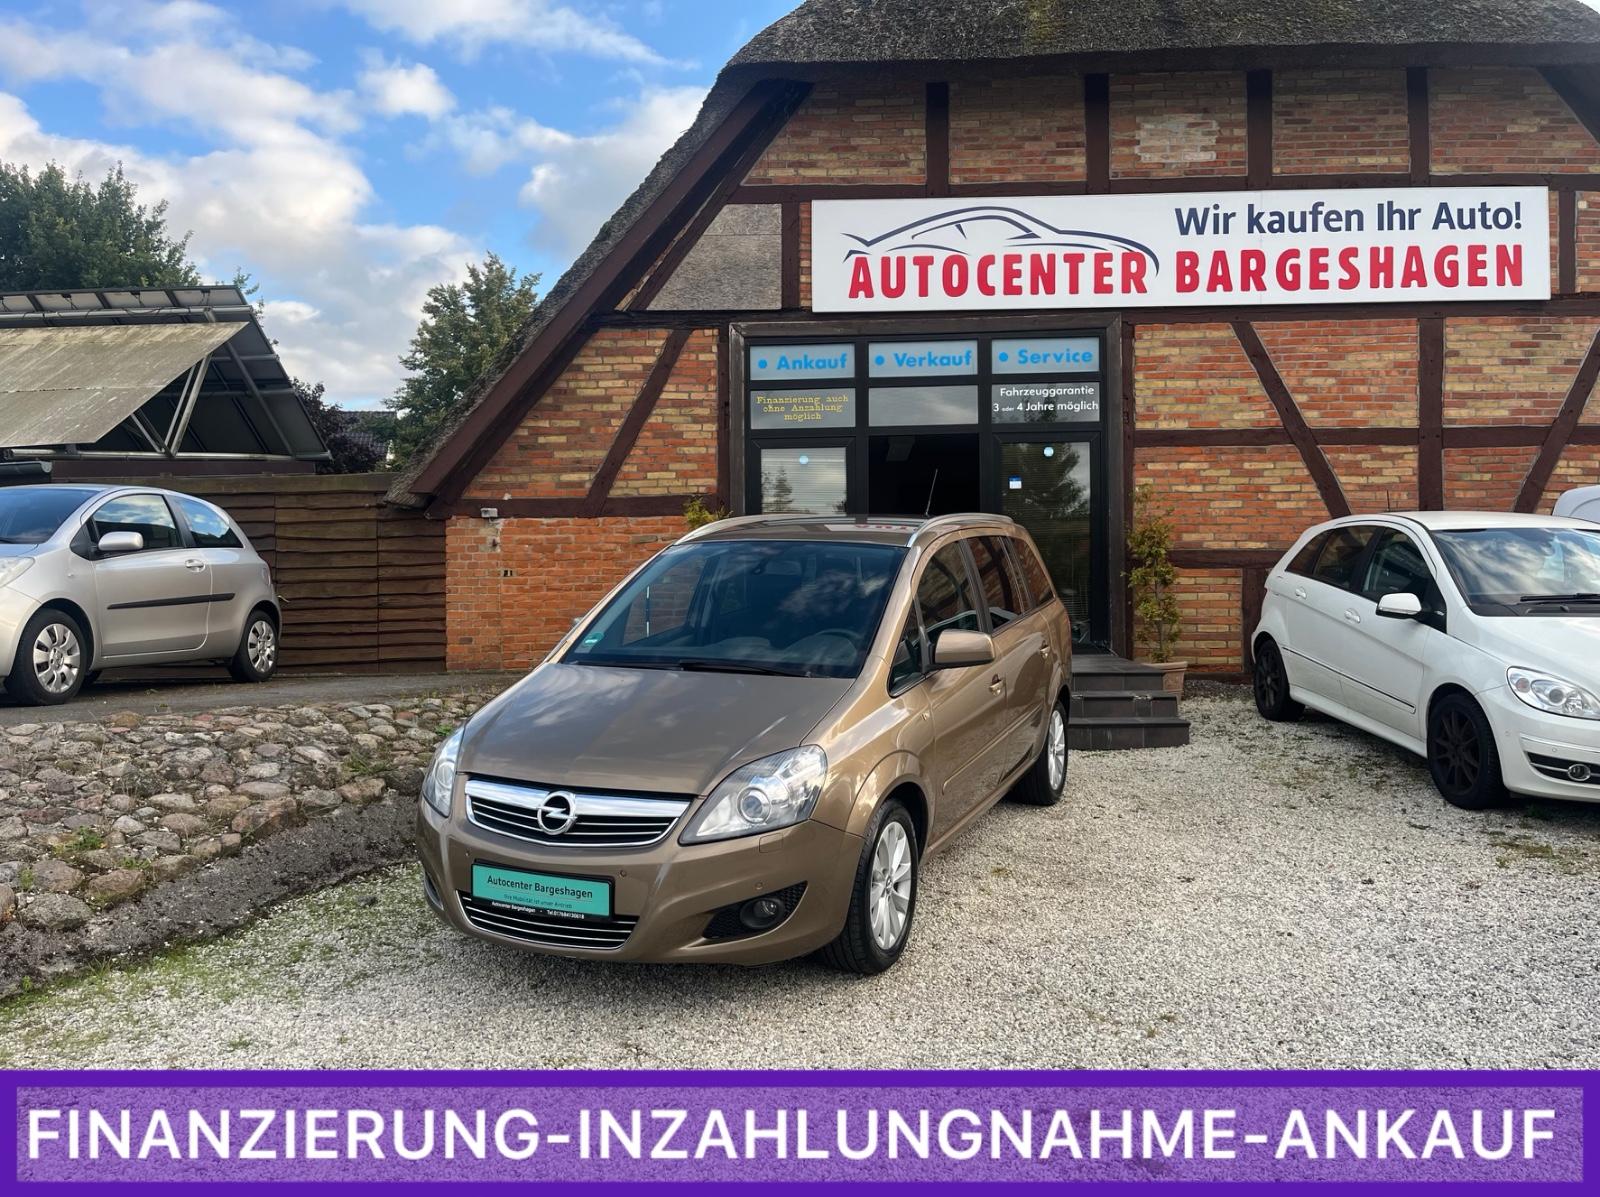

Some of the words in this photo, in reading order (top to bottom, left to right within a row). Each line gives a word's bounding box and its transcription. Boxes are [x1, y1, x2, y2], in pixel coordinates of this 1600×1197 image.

[1174, 203, 1237, 236] Wir
[1247, 201, 1364, 234] kaufen
[1376, 200, 1422, 231] Ihr
[1432, 201, 1522, 231] Auto!
[848, 252, 1147, 299] AUTOCENTER
[1175, 244, 1522, 293] BARGESHAGEN
[777, 352, 847, 370] Ankauf
[894, 349, 972, 368] Verkauf
[1017, 347, 1093, 365] Service
[756, 396, 821, 405] Finanzierung
[826, 394, 849, 402] auch
[1000, 385, 1095, 398] Fahrzeuggarantie
[763, 404, 785, 413] ohne
[791, 404, 843, 413] Anzahlung
[993, 403, 1000, 412] 3
[1016, 402, 1023, 411] 4
[1025, 402, 1054, 411] Jahre
[1057, 401, 1099, 412] möglich
[784, 412, 822, 422] möglich
[487, 875, 532, 890] Autocenter
[534, 882, 593, 899] Bargeshagen
